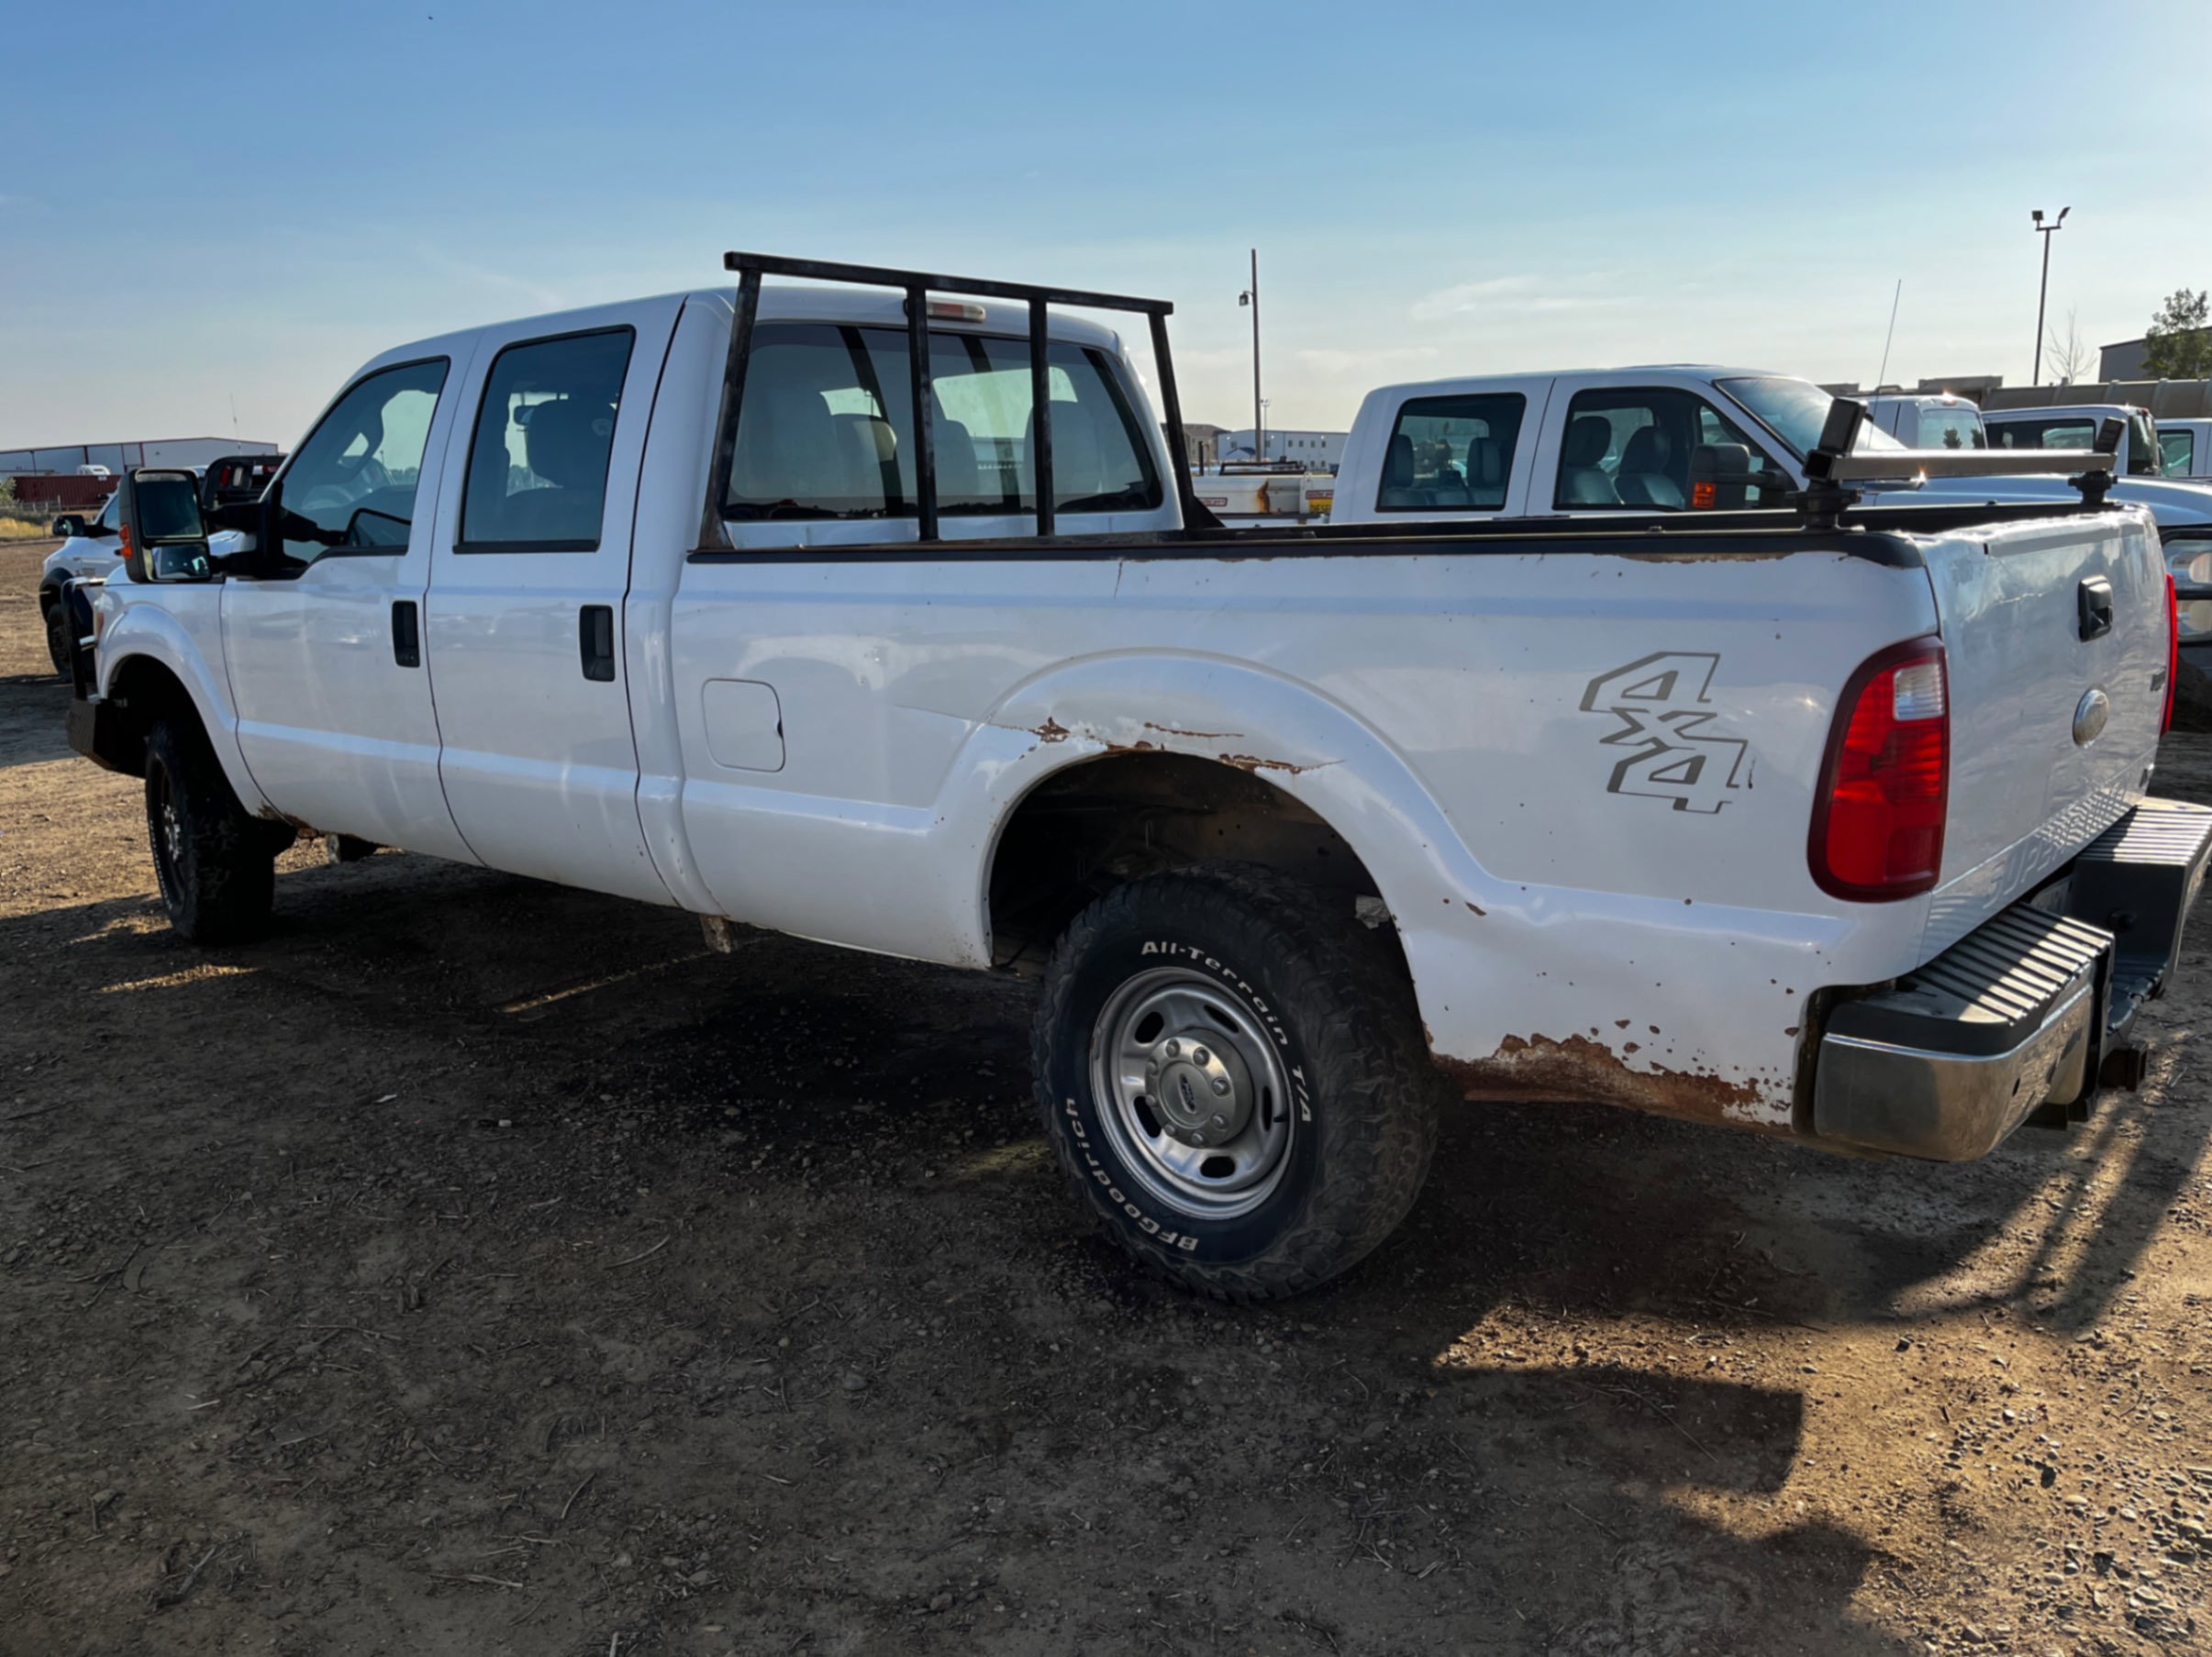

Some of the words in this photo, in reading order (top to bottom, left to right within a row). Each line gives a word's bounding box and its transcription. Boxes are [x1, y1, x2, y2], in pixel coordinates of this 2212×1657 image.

[1140, 941, 1288, 1045] All-Terrain
[1292, 1065, 1312, 1121] T/A
[1066, 1098, 1199, 1251] BFGoodrich
